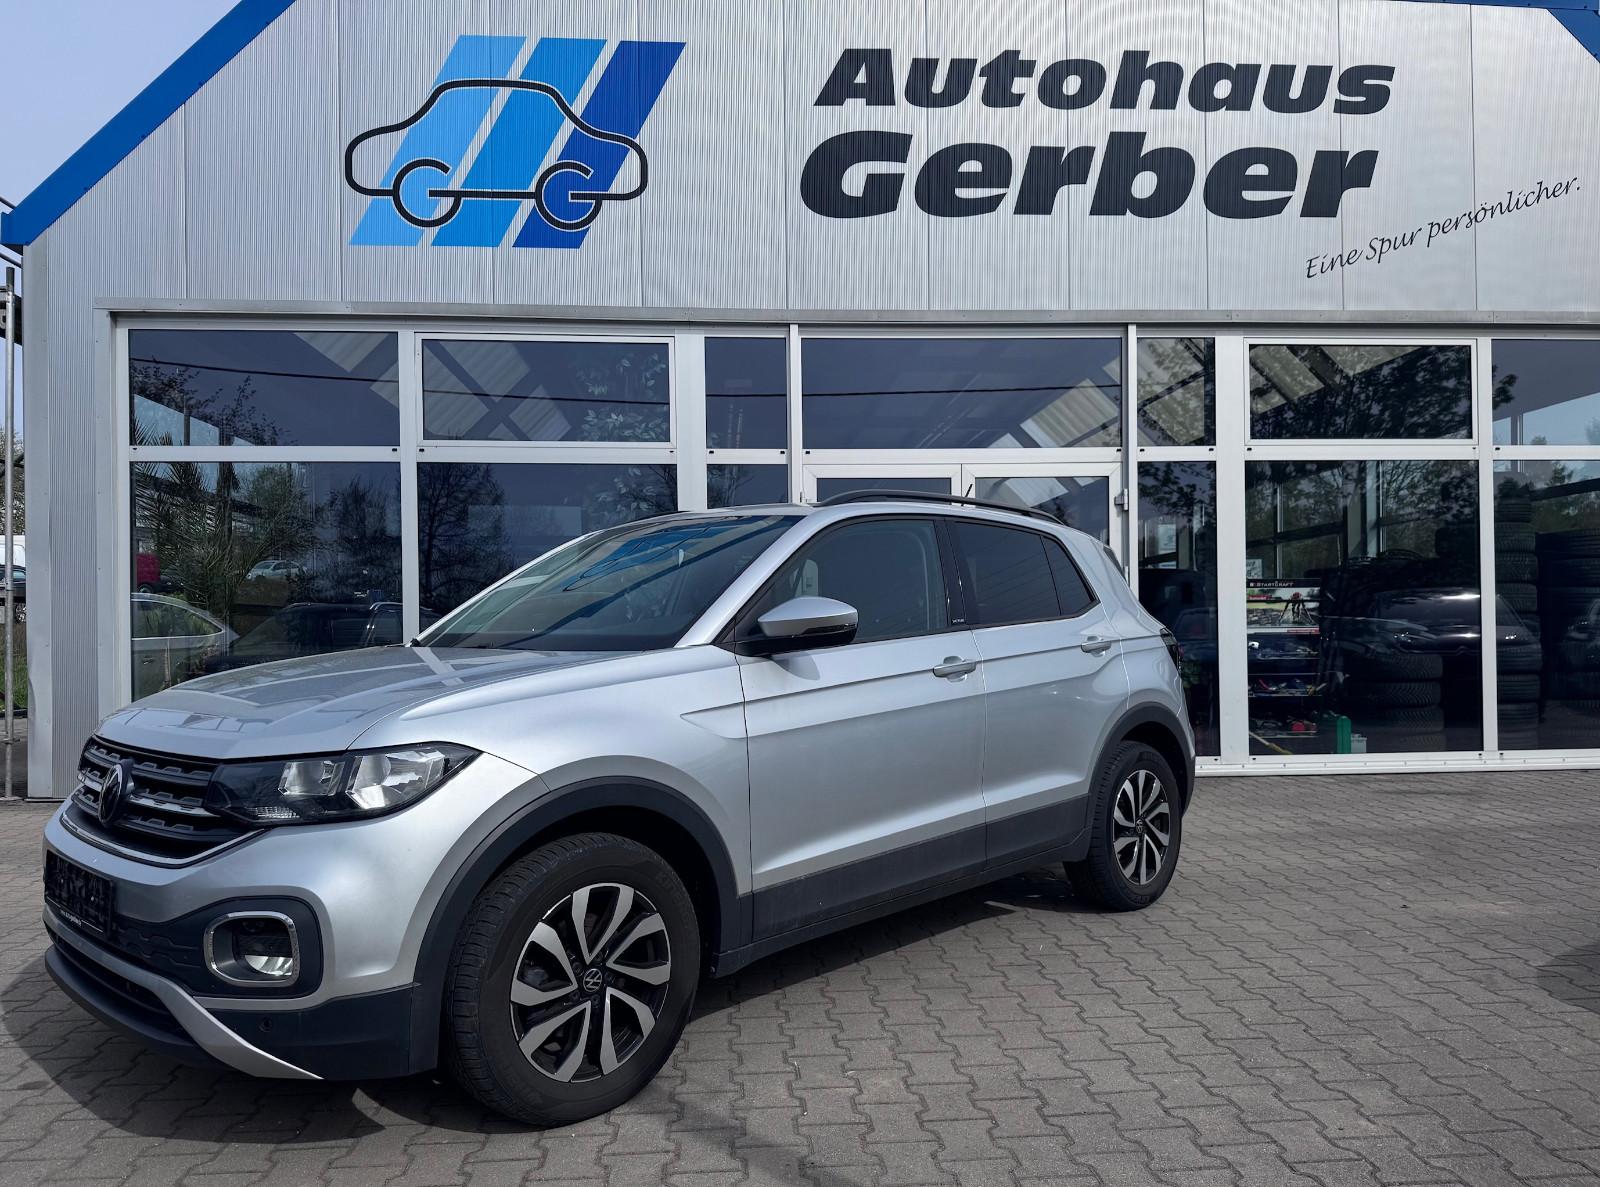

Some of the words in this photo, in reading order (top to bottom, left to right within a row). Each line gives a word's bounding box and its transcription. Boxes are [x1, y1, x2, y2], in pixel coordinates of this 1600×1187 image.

[813, 48, 1396, 115] Autohaus
[799, 130, 1379, 219] Gerber
[1306, 248, 1363, 279] Eine
[1365, 227, 1423, 264] Spur
[1427, 176, 1581, 248] persönlicher.
